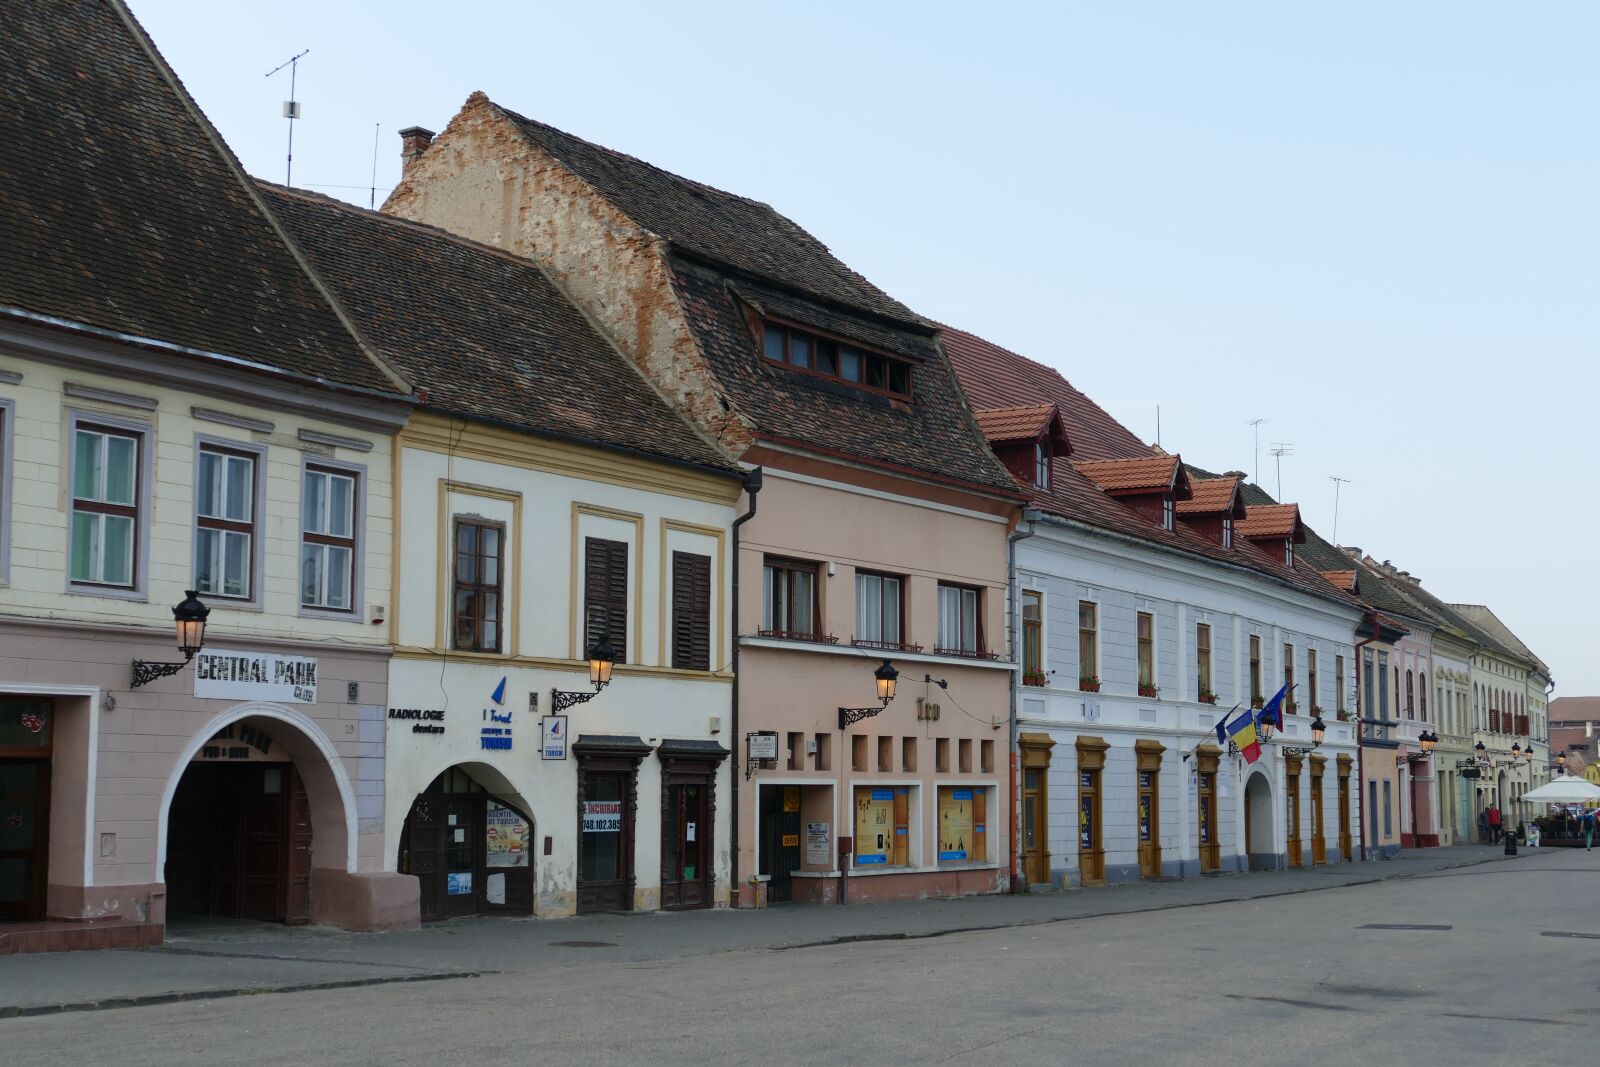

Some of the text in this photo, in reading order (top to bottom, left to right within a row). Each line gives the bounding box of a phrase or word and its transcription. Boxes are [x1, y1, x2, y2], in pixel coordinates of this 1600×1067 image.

[198, 655, 316, 686] CENTRAL PARK
[294, 686, 313, 702] CLUB
[388, 708, 446, 721] RADIOLOGIE
[412, 723, 446, 735] dentara
[481, 737, 512, 750] TURISM
